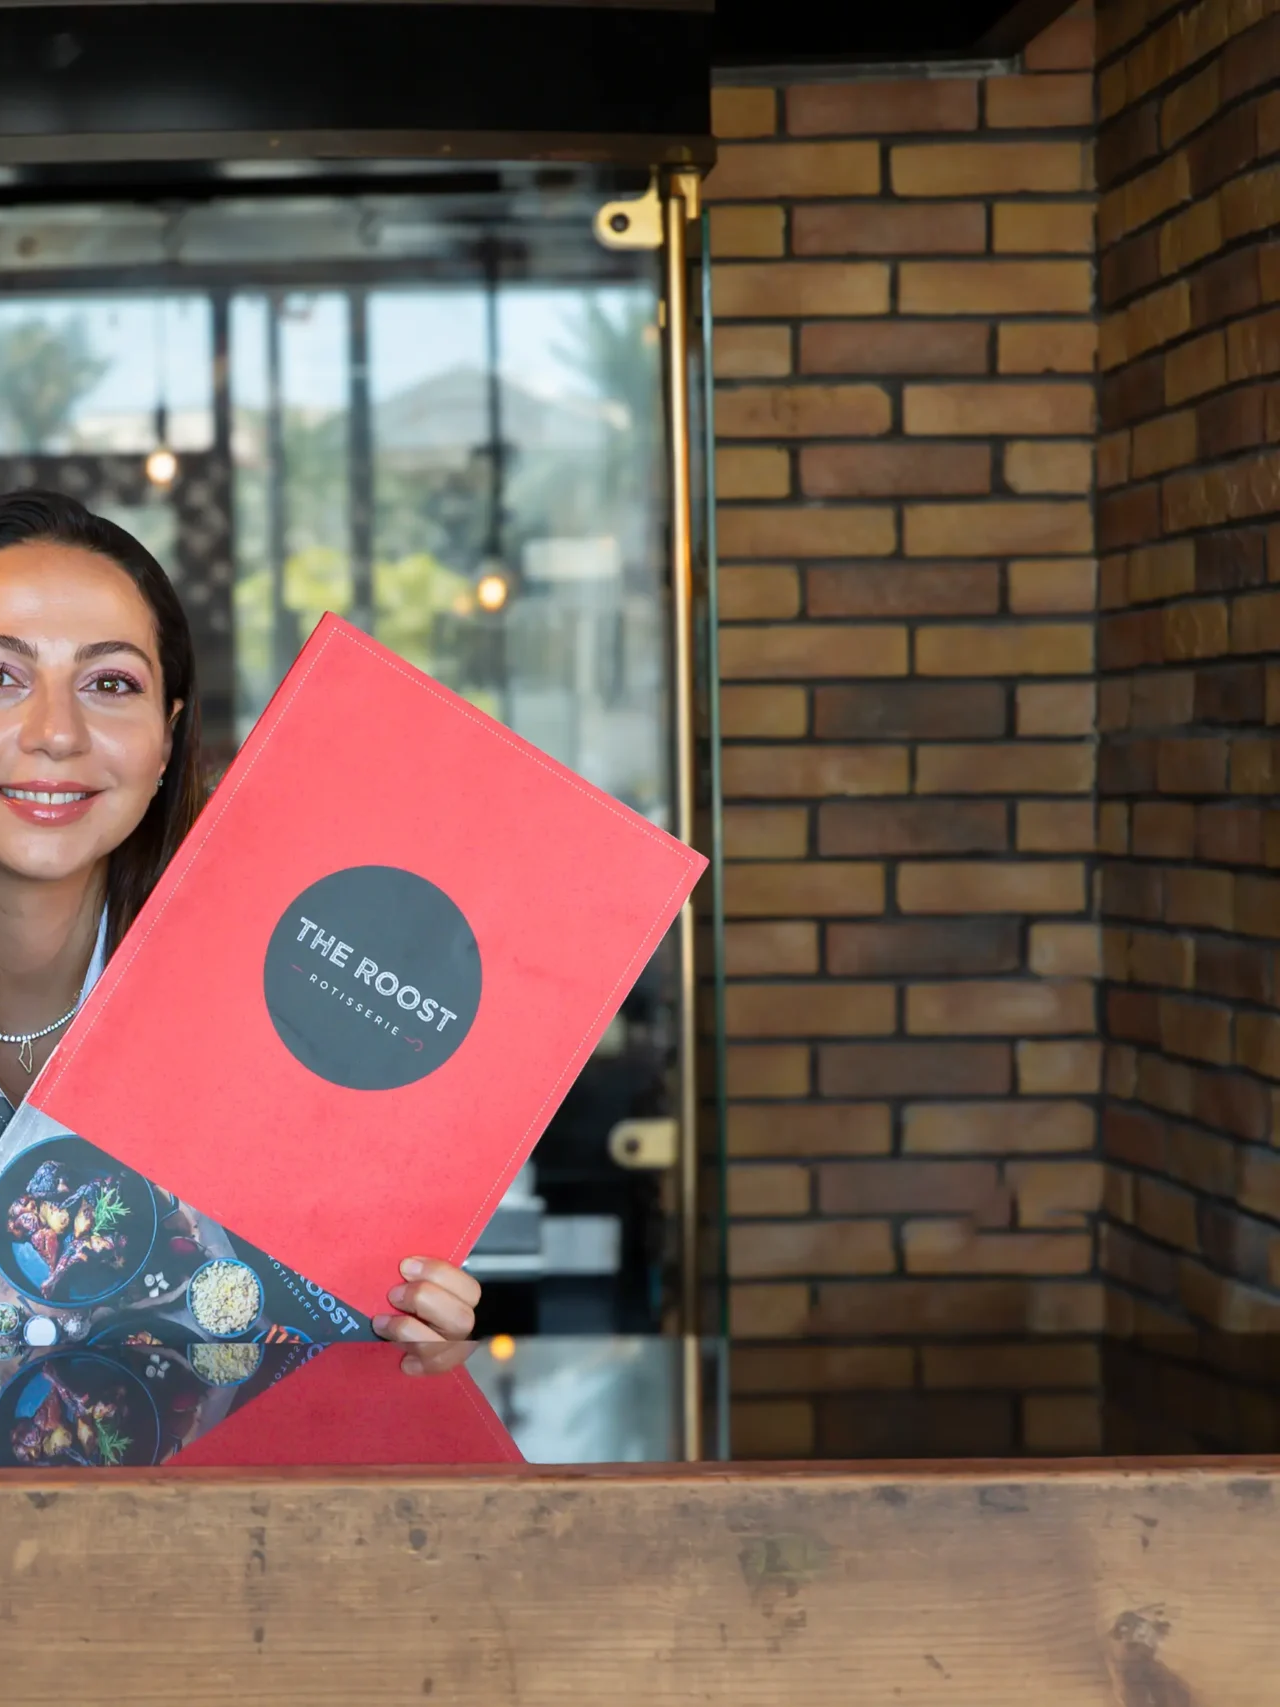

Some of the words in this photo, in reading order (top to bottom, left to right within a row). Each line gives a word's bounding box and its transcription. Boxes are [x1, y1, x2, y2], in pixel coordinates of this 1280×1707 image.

[296, 916, 354, 969] THE
[353, 956, 458, 1032] ROOST
[309, 973, 400, 1036] ROTISSERIE
[294, 1269, 360, 1335] OOST
